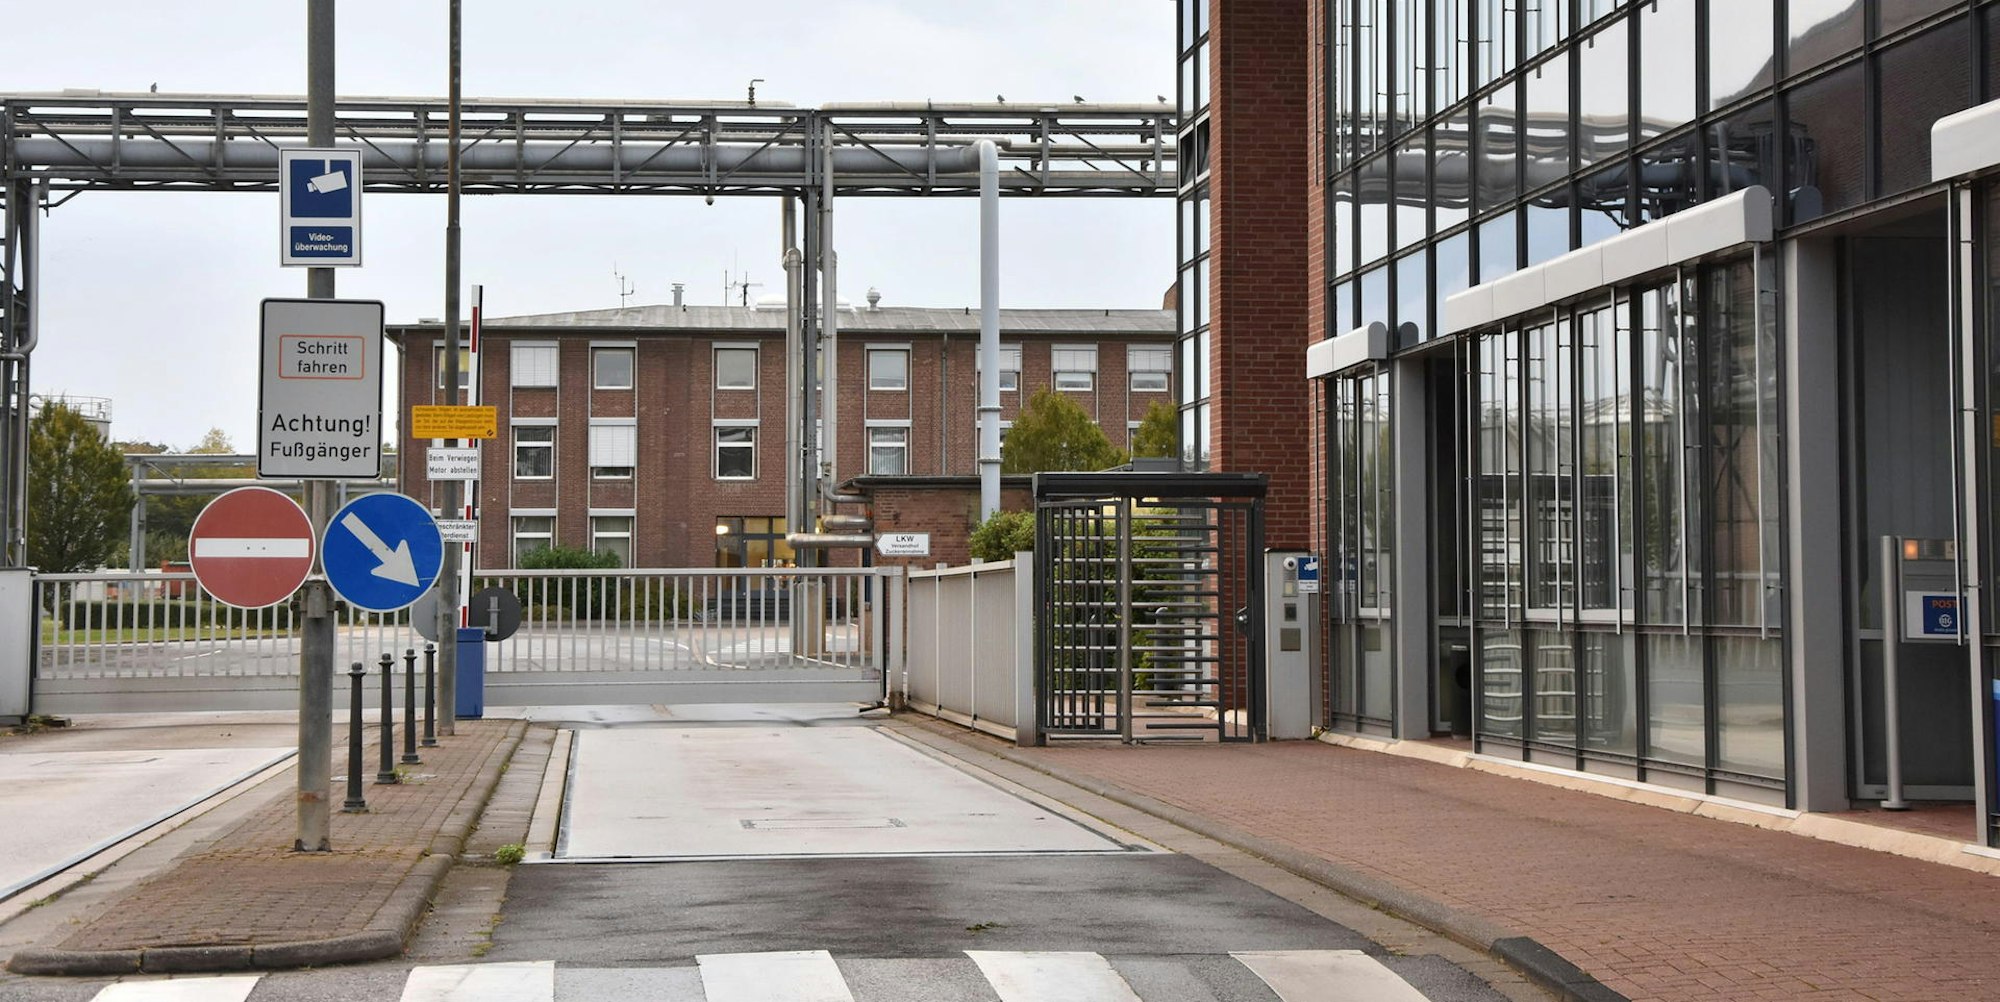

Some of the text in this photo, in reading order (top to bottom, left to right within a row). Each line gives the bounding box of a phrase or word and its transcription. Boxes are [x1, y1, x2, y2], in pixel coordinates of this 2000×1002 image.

[308, 233, 334, 241] Video-
[295, 243, 348, 253] überwachung
[297, 341, 348, 355] Schritt
[298, 360, 347, 373] fahren
[271, 413, 370, 437] Achtung!
[271, 442, 371, 461] Fußgänger
[447, 454, 477, 463] Verwiegen
[429, 466, 477, 474] Motor abstellen
